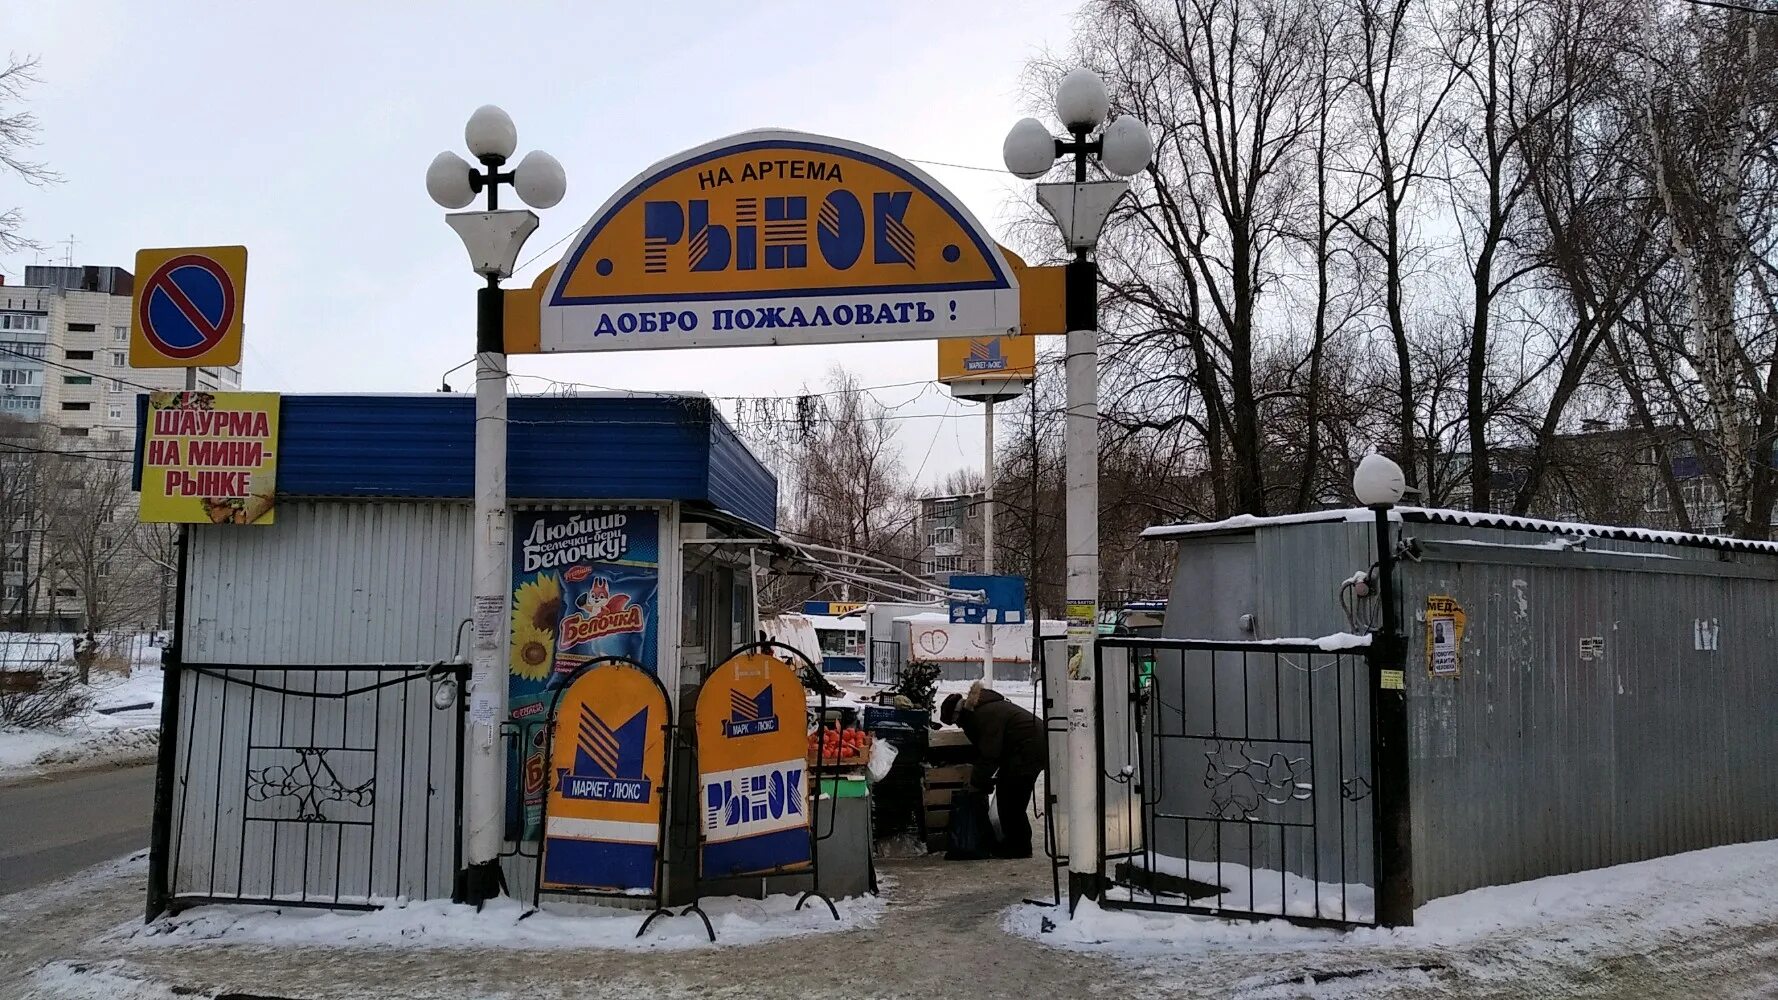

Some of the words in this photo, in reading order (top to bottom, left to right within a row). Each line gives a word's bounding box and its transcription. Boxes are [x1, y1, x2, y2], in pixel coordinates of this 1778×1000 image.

[698, 166, 735, 190] НА
[741, 160, 843, 183] АРТЕМА
[644, 188, 916, 274] РЫНОК
[594, 310, 698, 337] ДОБРО
[712, 301, 935, 330] ПОЖАЛОВАТЬ
[154, 410, 270, 437] ШАУРМА
[148, 440, 180, 466] НА
[187, 440, 273, 467] МИНИ-
[165, 470, 250, 497] РЫНКЕ
[523, 513, 627, 547] Любишь
[523, 534, 627, 572] Белочку!
[707, 769, 803, 830] РЫНОК
